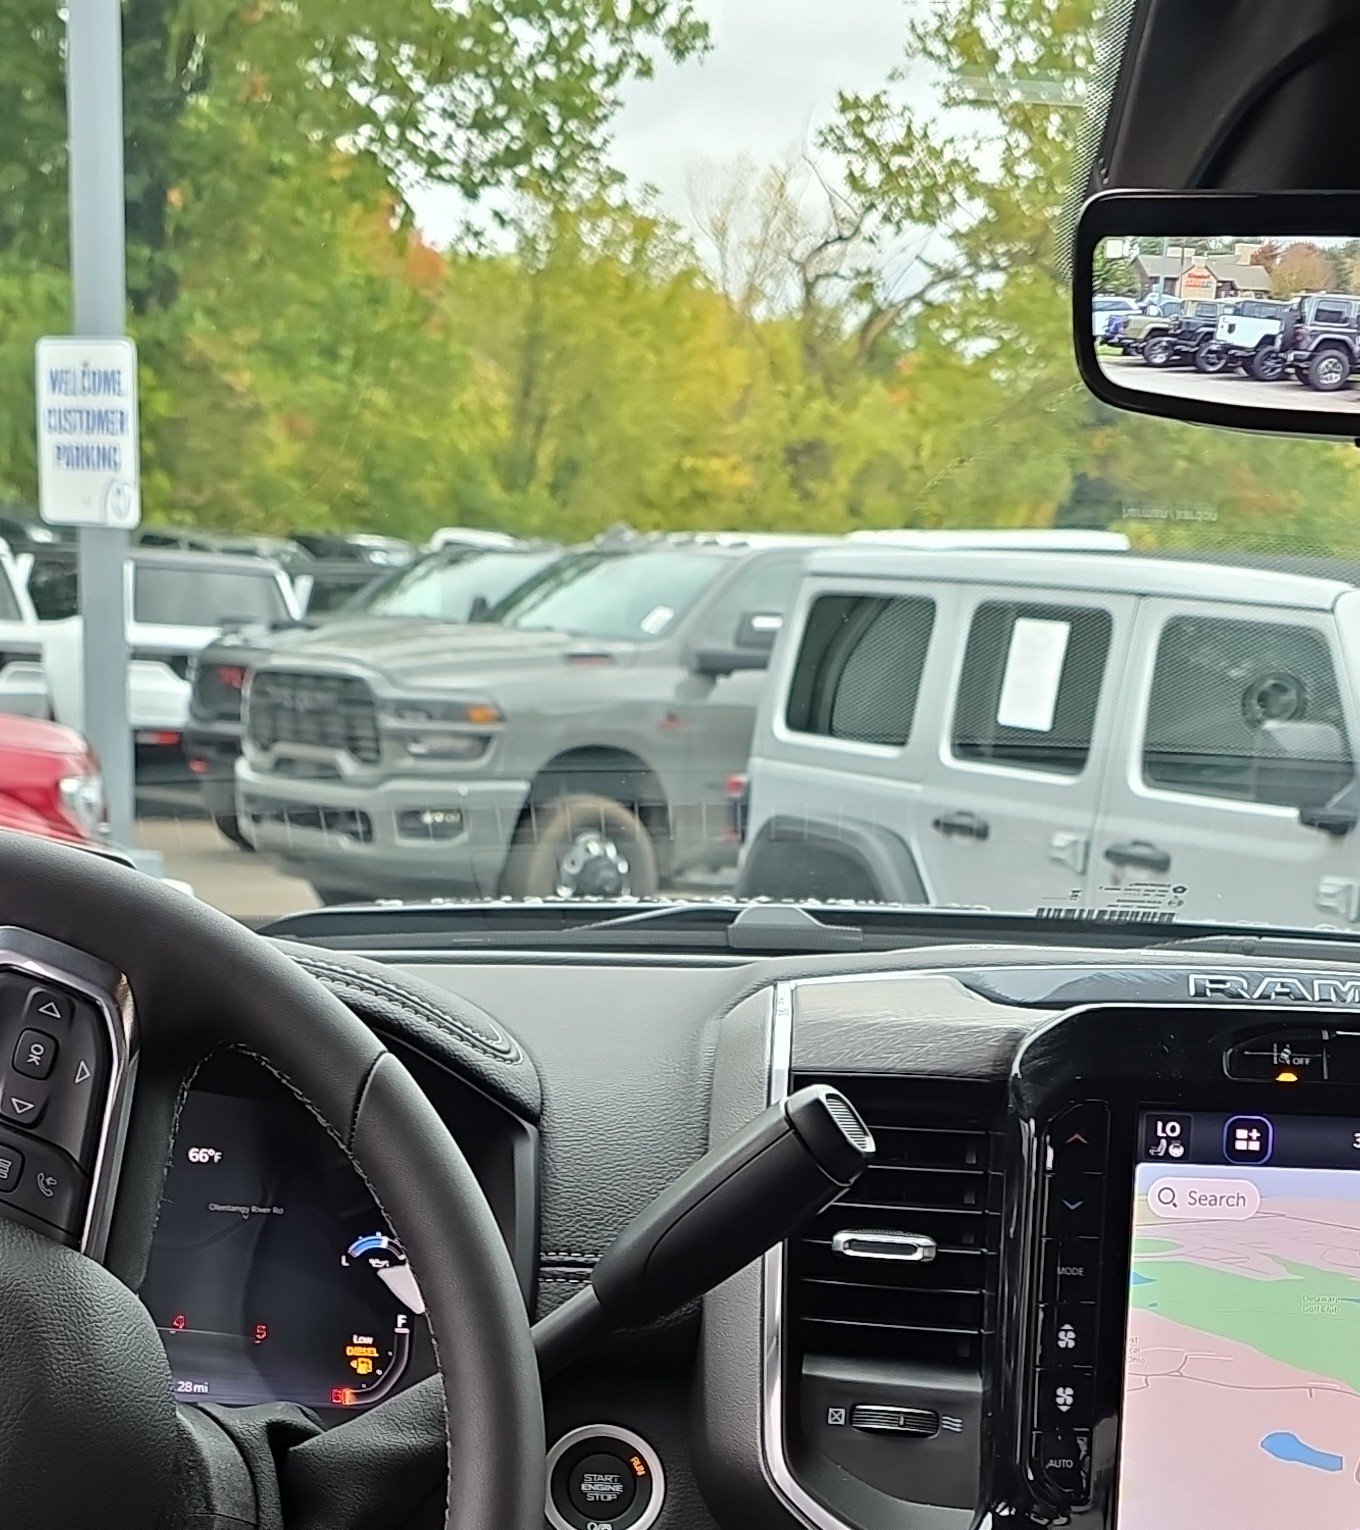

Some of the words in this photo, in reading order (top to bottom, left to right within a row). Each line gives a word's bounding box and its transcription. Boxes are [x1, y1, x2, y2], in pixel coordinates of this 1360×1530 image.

[49, 368, 122, 396] WELCOME
[48, 408, 125, 435] CUSTOMER
[56, 444, 121, 471] PARKING
[27, 1043, 44, 1066] OK
[1156, 1120, 1181, 1137] LO
[1187, 1190, 1246, 1207] Search
[1056, 1266, 1084, 1277] MODE
[397, 1314, 407, 1328] F
[630, 1456, 646, 1476] RUN
[1047, 1459, 1074, 1468] AUTO
[583, 1474, 621, 1483] START
[581, 1483, 623, 1493] ENGINE
[586, 1493, 617, 1501] STOP
